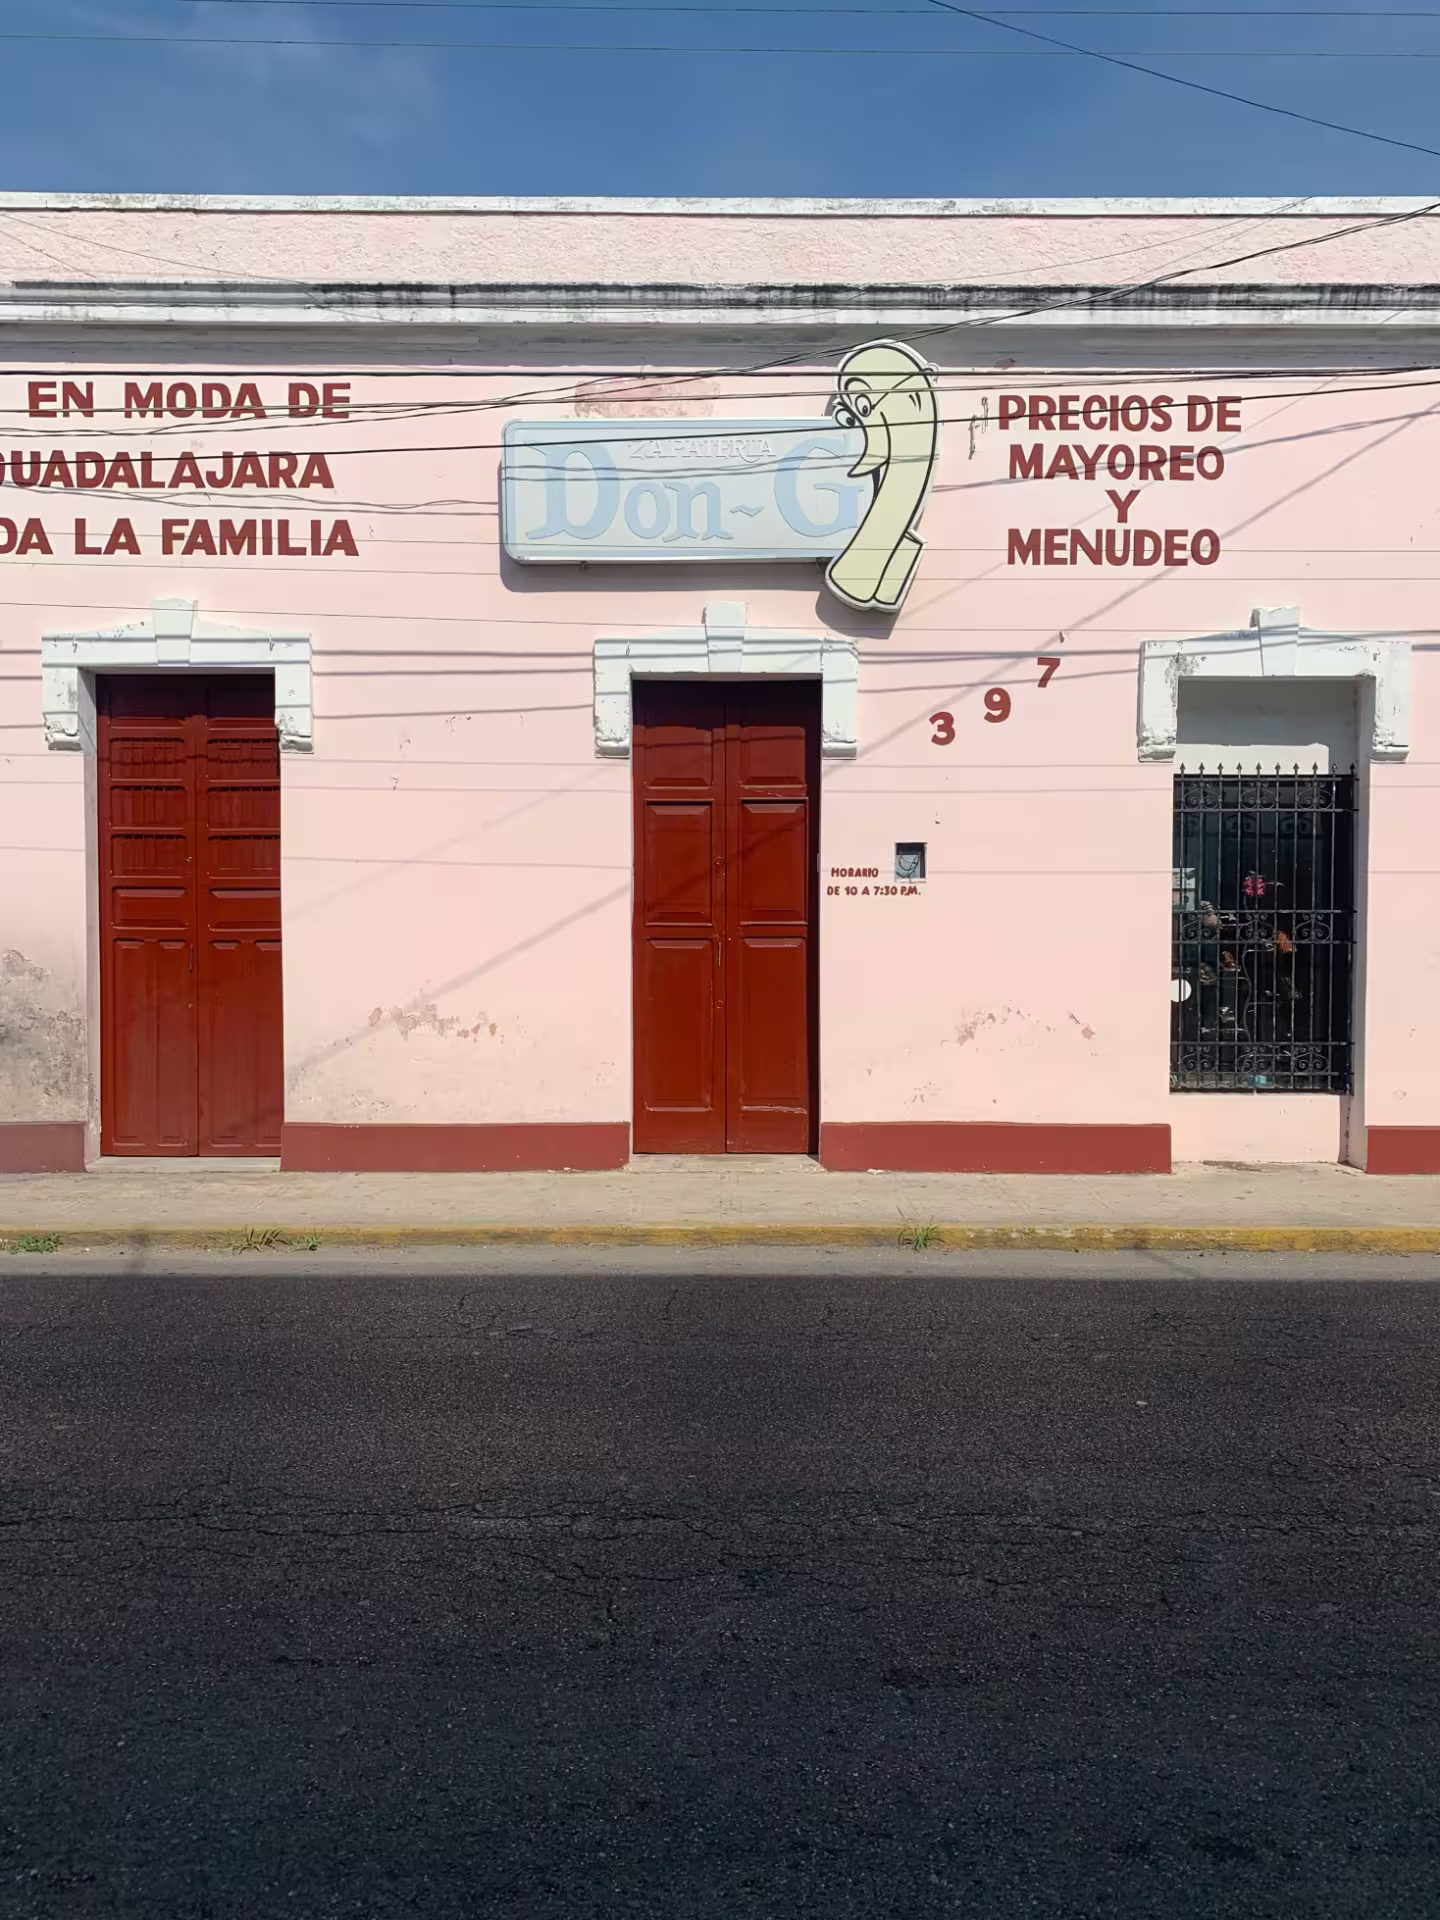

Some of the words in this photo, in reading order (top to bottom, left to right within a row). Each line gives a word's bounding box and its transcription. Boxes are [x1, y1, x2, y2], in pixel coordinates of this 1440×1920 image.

[27, 381, 94, 418] EN
[124, 382, 267, 419] MODA
[287, 382, 351, 419] DE
[998, 394, 1174, 432] PRECIOS
[1185, 395, 1242, 433] DE
[0, 449, 335, 489] UADALAJARA
[1009, 443, 1225, 481] MAYOREO
[1105, 489, 1141, 524] Y
[74, 517, 141, 555] LA
[161, 518, 360, 557] FAMILIA
[1007, 528, 1221, 566] MENUDEO
[826, 886, 841, 896] DE
[844, 886, 859, 896] 10
[861, 886, 871, 896] A
[873, 886, 898, 896] 7:30
[830, 867, 880, 878] HORARIO
